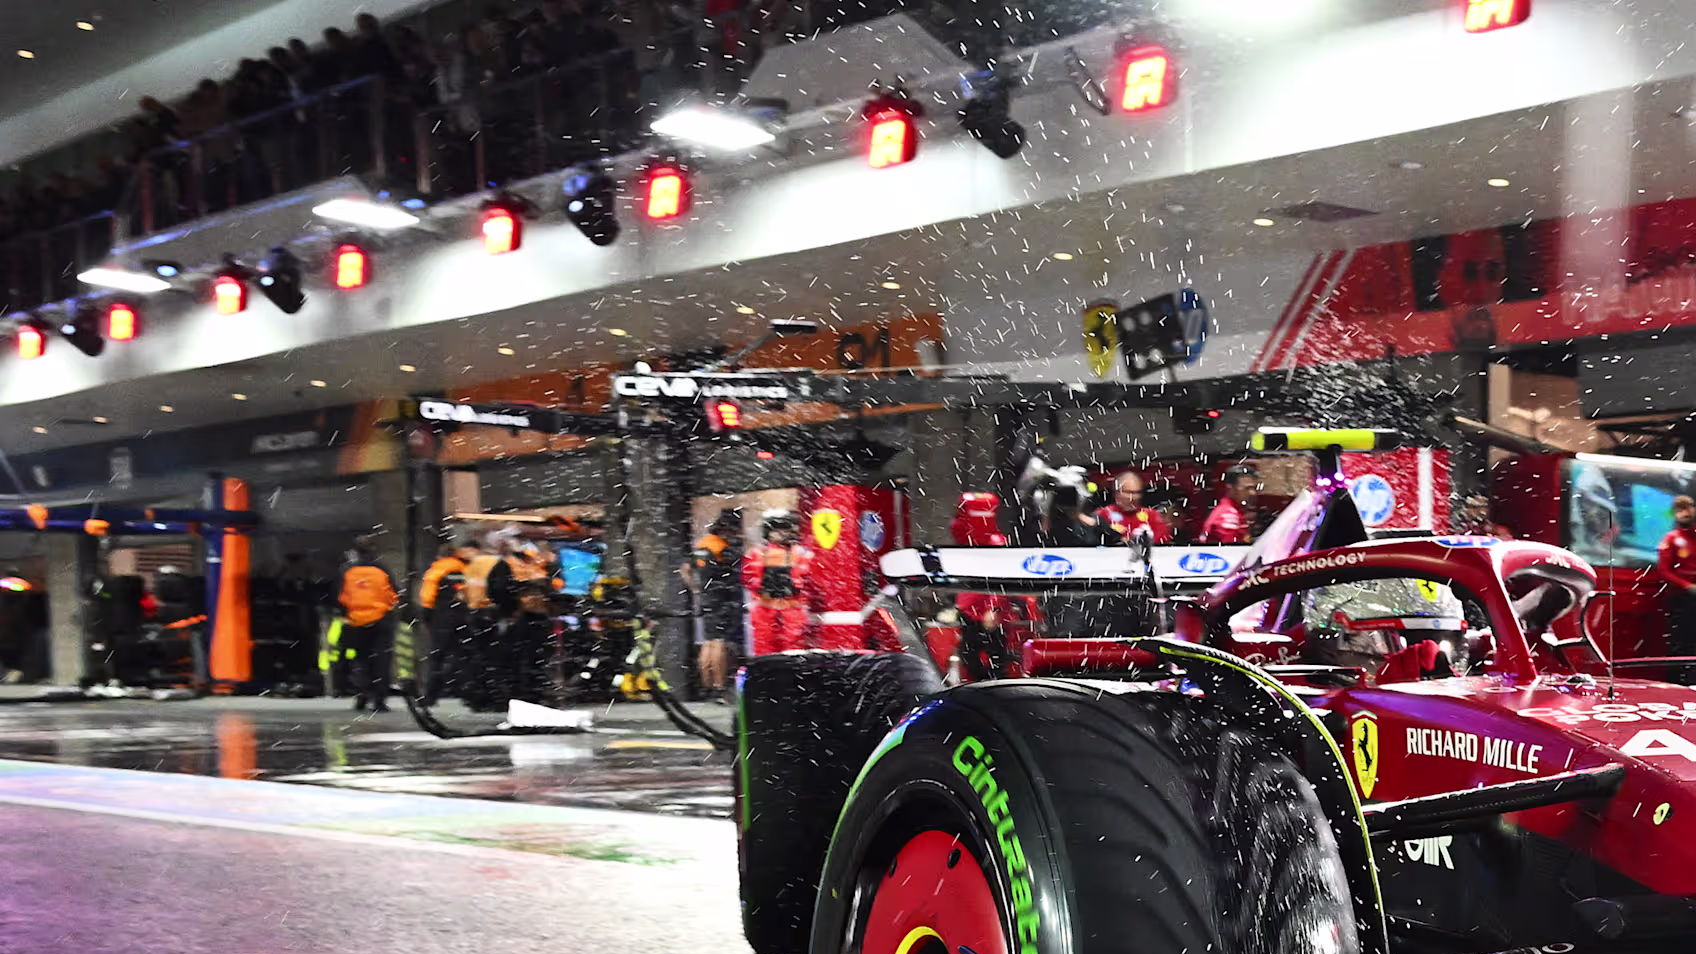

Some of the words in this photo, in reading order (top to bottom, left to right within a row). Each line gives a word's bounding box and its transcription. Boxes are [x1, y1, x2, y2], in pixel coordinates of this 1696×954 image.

[1273, 551, 1367, 577] TECHNOLOGY
[1406, 727, 1478, 762] RICHARD
[1483, 736, 1543, 774] MILLE
